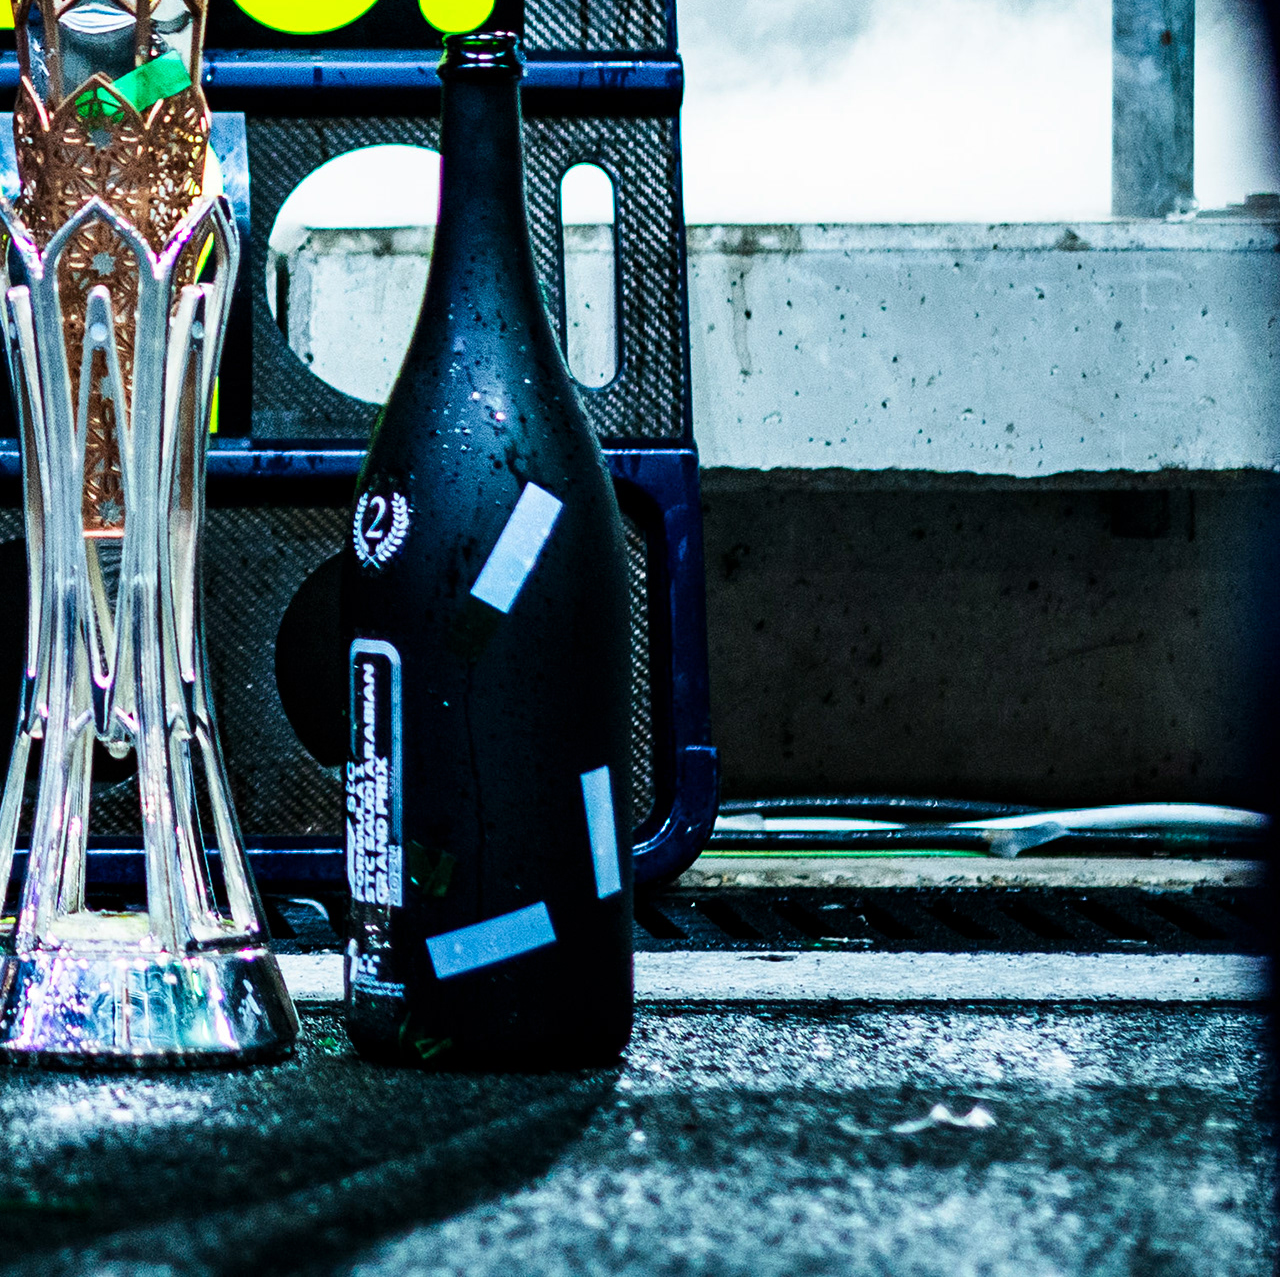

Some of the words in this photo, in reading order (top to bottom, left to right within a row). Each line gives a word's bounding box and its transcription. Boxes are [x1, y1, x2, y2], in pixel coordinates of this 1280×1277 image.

[365, 495, 386, 538] 2
[363, 663, 376, 777] ARABIAN
[364, 779, 376, 852] SAUDI
[375, 756, 389, 816] PRIX
[375, 817, 389, 905] GRAND
